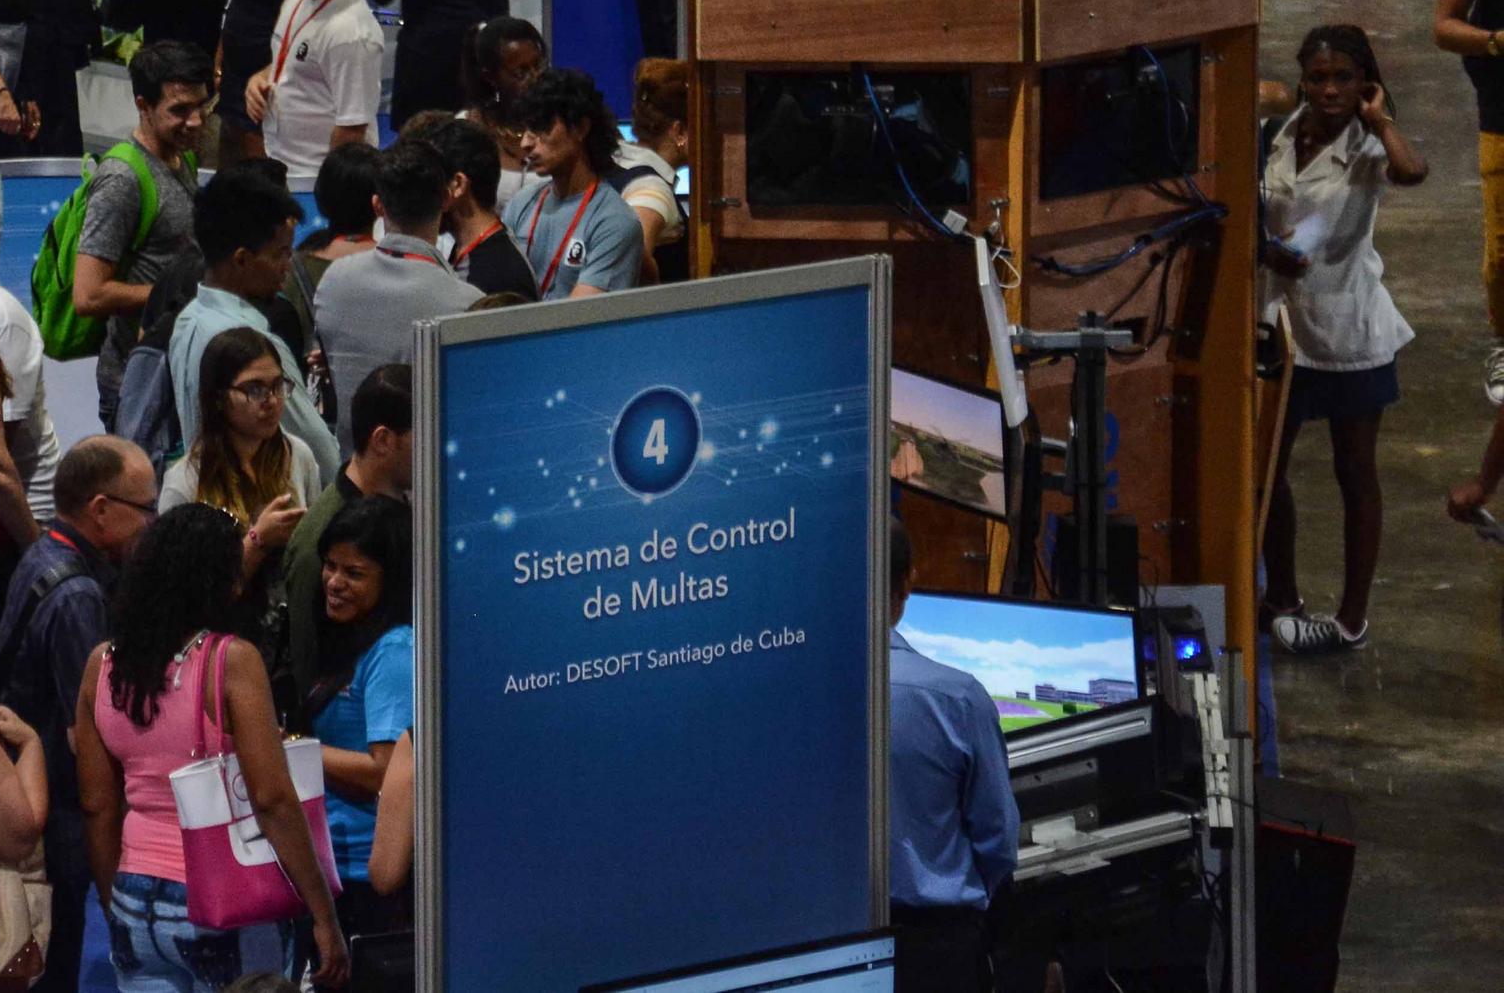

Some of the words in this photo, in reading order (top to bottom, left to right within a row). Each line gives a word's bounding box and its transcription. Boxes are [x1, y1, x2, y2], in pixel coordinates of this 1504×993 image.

[642, 417, 669, 466] 4
[513, 542, 631, 585] Sistema
[639, 529, 678, 564] de
[686, 506, 796, 555] Control
[582, 585, 622, 620] de
[631, 571, 729, 612] Multas
[503, 670, 561, 695] Autor:
[566, 651, 642, 684] DESOFT
[646, 641, 727, 672] Santiago
[730, 633, 754, 655] de
[758, 626, 806, 650] Cuba
